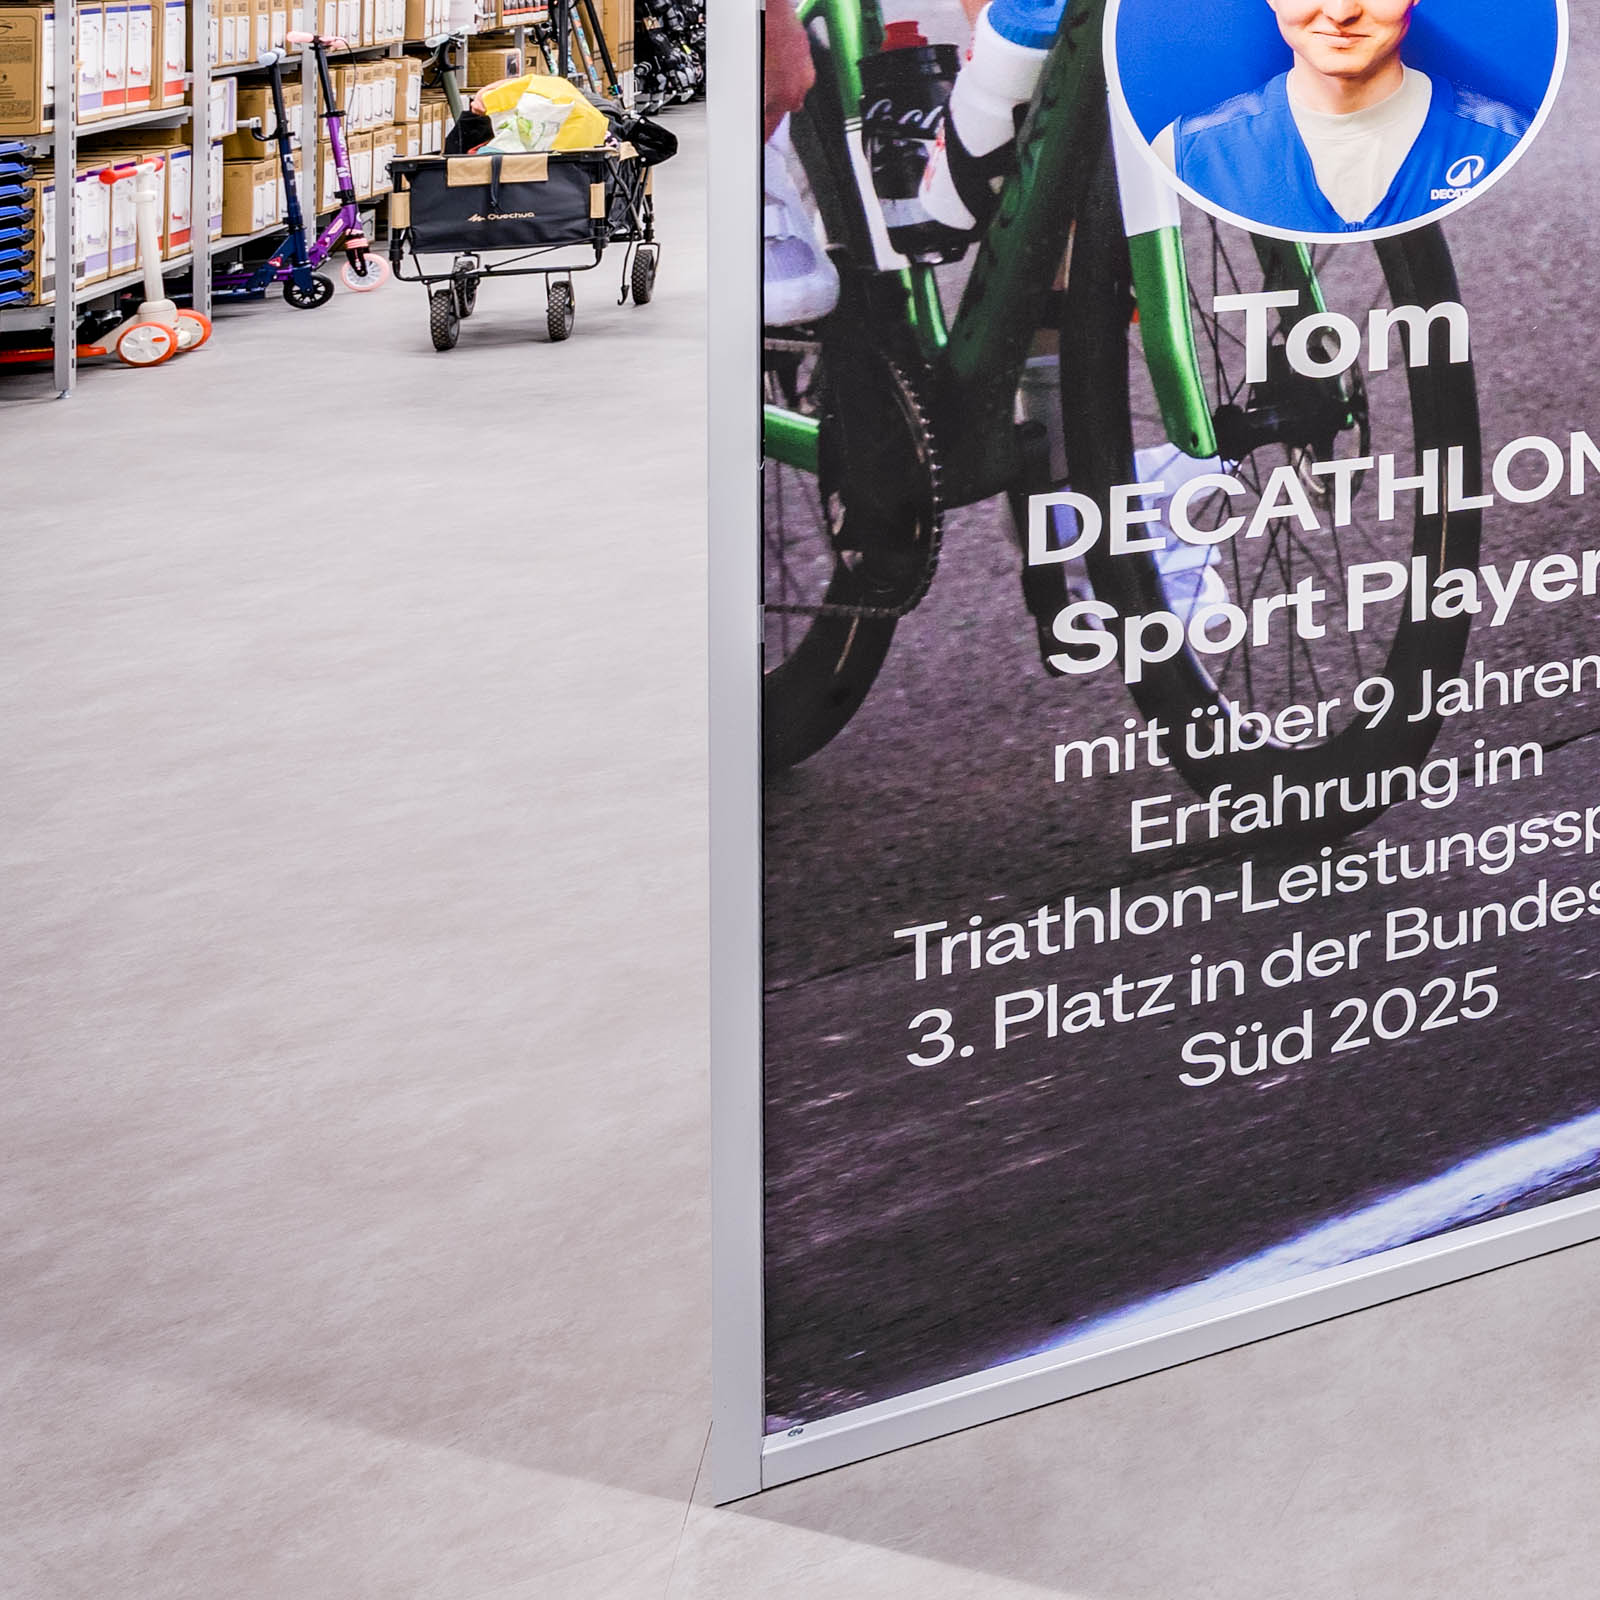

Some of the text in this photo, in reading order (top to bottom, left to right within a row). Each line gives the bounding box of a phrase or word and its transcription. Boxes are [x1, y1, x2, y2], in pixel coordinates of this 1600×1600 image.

[1214, 290, 1469, 385] Tom
[1048, 587, 1326, 684] Sport
[1054, 717, 1170, 783] mit
[1185, 694, 1341, 762] über
[1353, 677, 1395, 730] 9
[1130, 740, 1544, 854] Erfahrung im
[907, 1008, 974, 1069] 3.
[995, 971, 1176, 1051] Platz
[1191, 956, 1245, 1007] in
[1261, 927, 1371, 988] der
[1178, 966, 1500, 1088] Süd 2025
